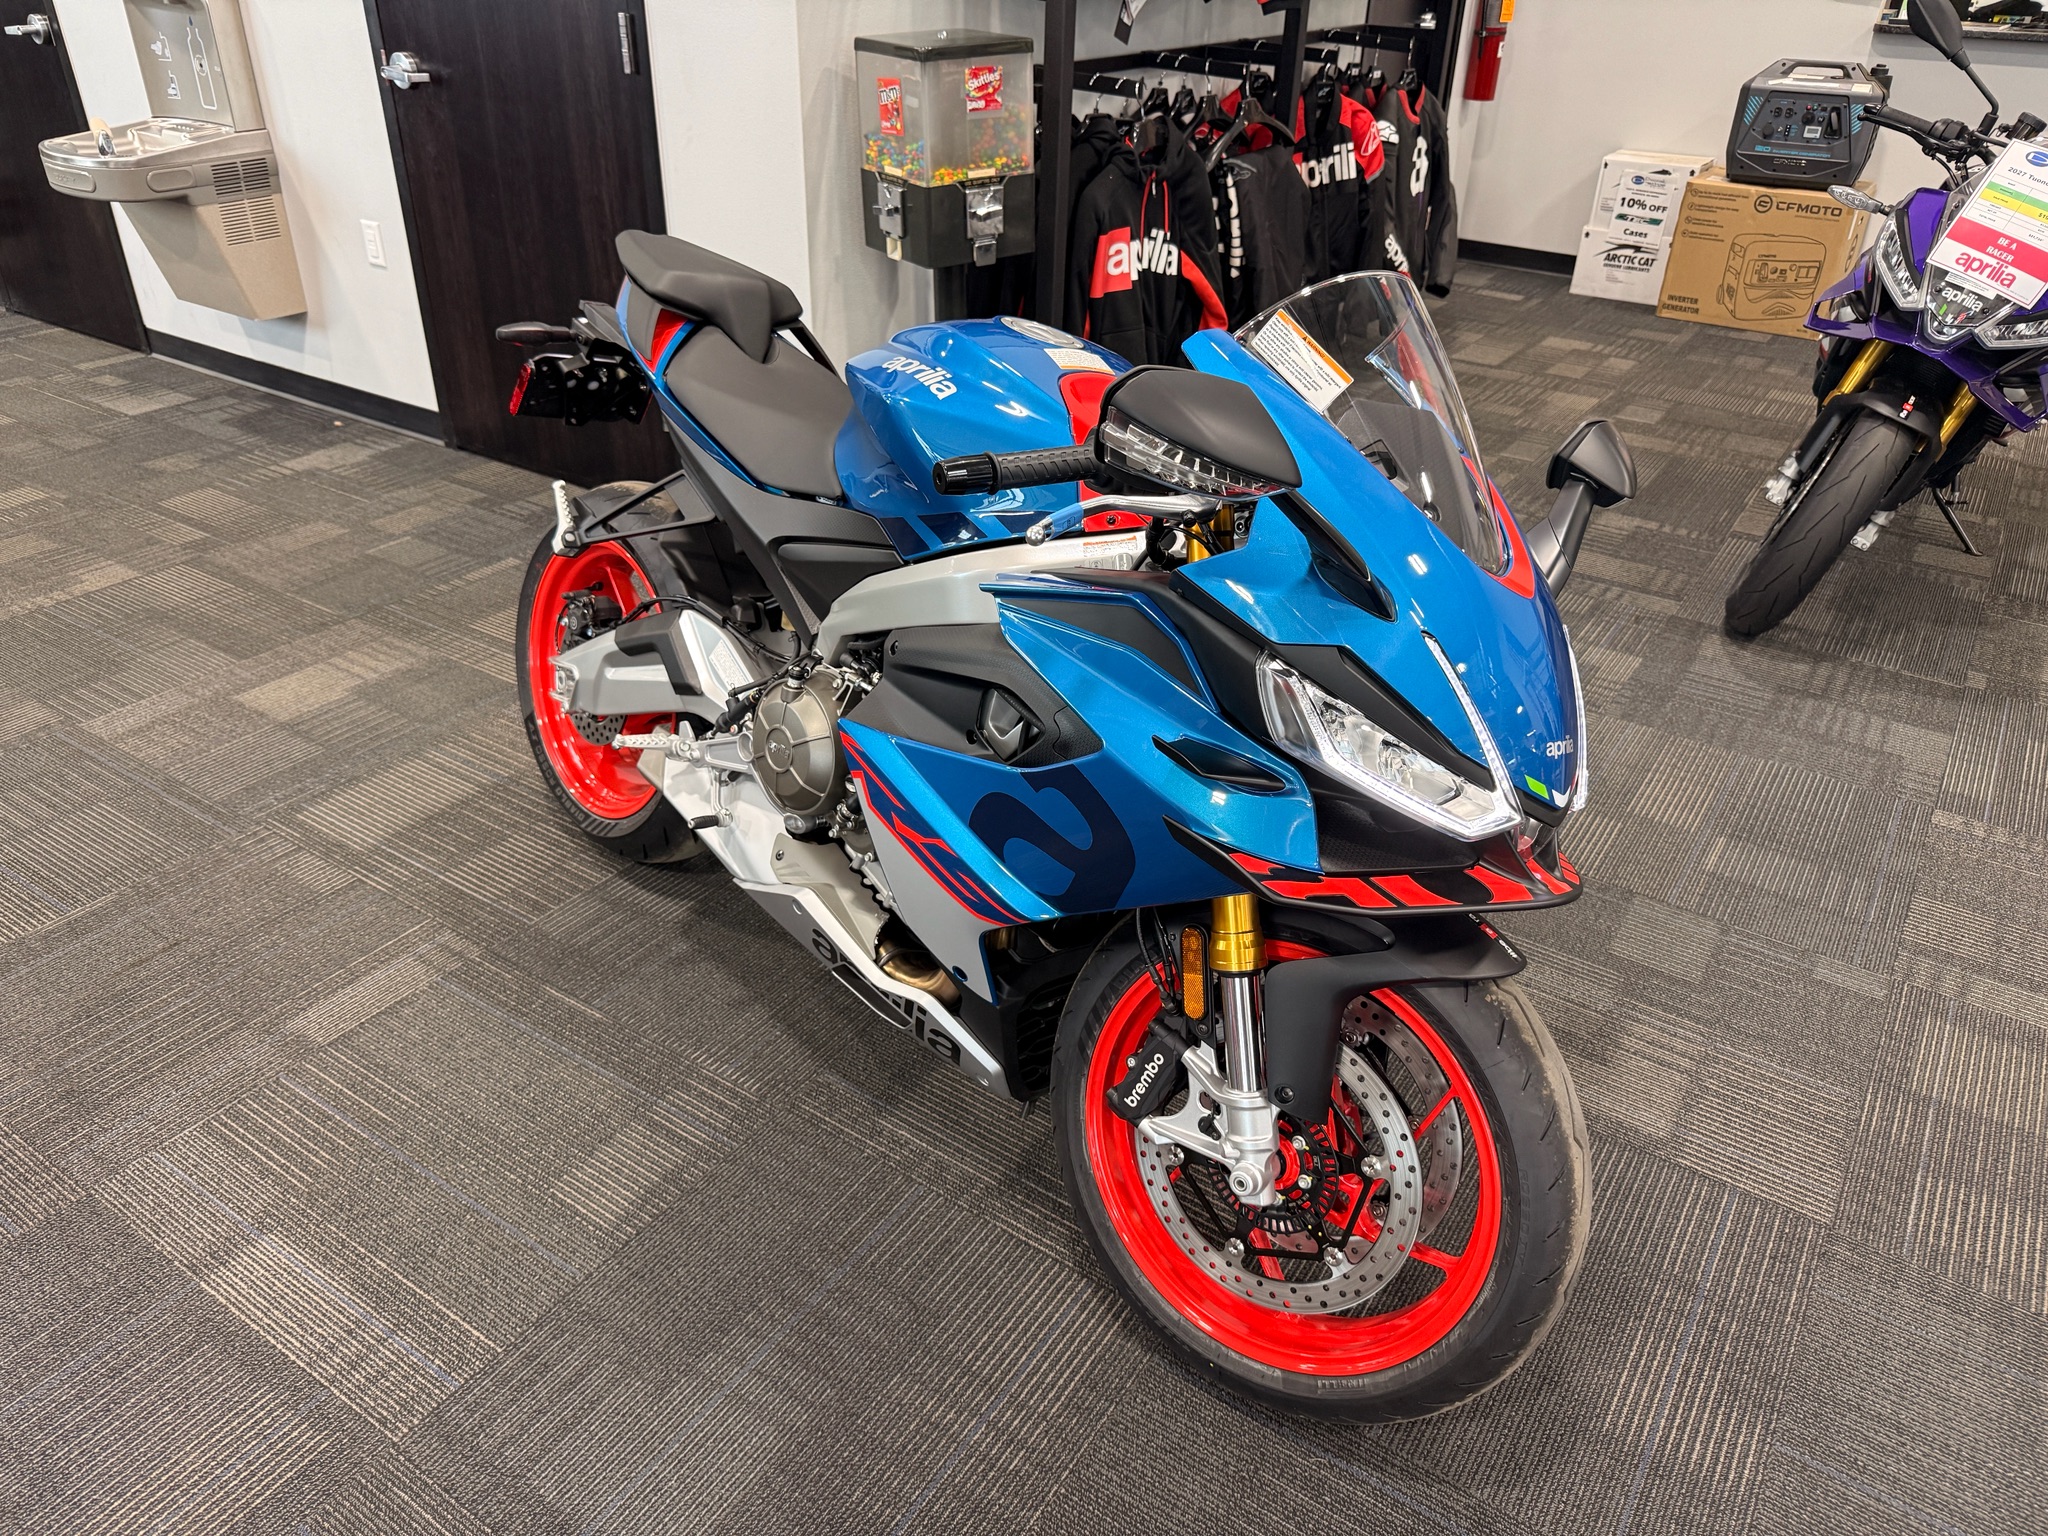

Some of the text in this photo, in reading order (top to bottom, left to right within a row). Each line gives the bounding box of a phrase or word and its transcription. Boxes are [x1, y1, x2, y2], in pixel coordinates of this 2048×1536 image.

[967, 71, 1000, 90] Skittles
[2008, 166, 2027, 177] 2027
[1620, 196, 1647, 210] 10%
[1648, 204, 1668, 214] OFF
[1776, 201, 1843, 217] CFMOTO
[1623, 228, 1648, 238] Cases
[1997, 236, 2017, 250] BE A
[1107, 227, 1179, 281] aprilia
[1604, 252, 1658, 268] ARCTIC CAT
[1986, 246, 2014, 262] RACER
[1955, 251, 2017, 289] aprilia
[1667, 294, 1699, 305] INVERTER
[1942, 286, 1984, 312] aprilia
[1662, 302, 1700, 314] GENERATOR
[881, 356, 958, 400] aprilia
[1124, 1053, 1164, 1108] brembo
